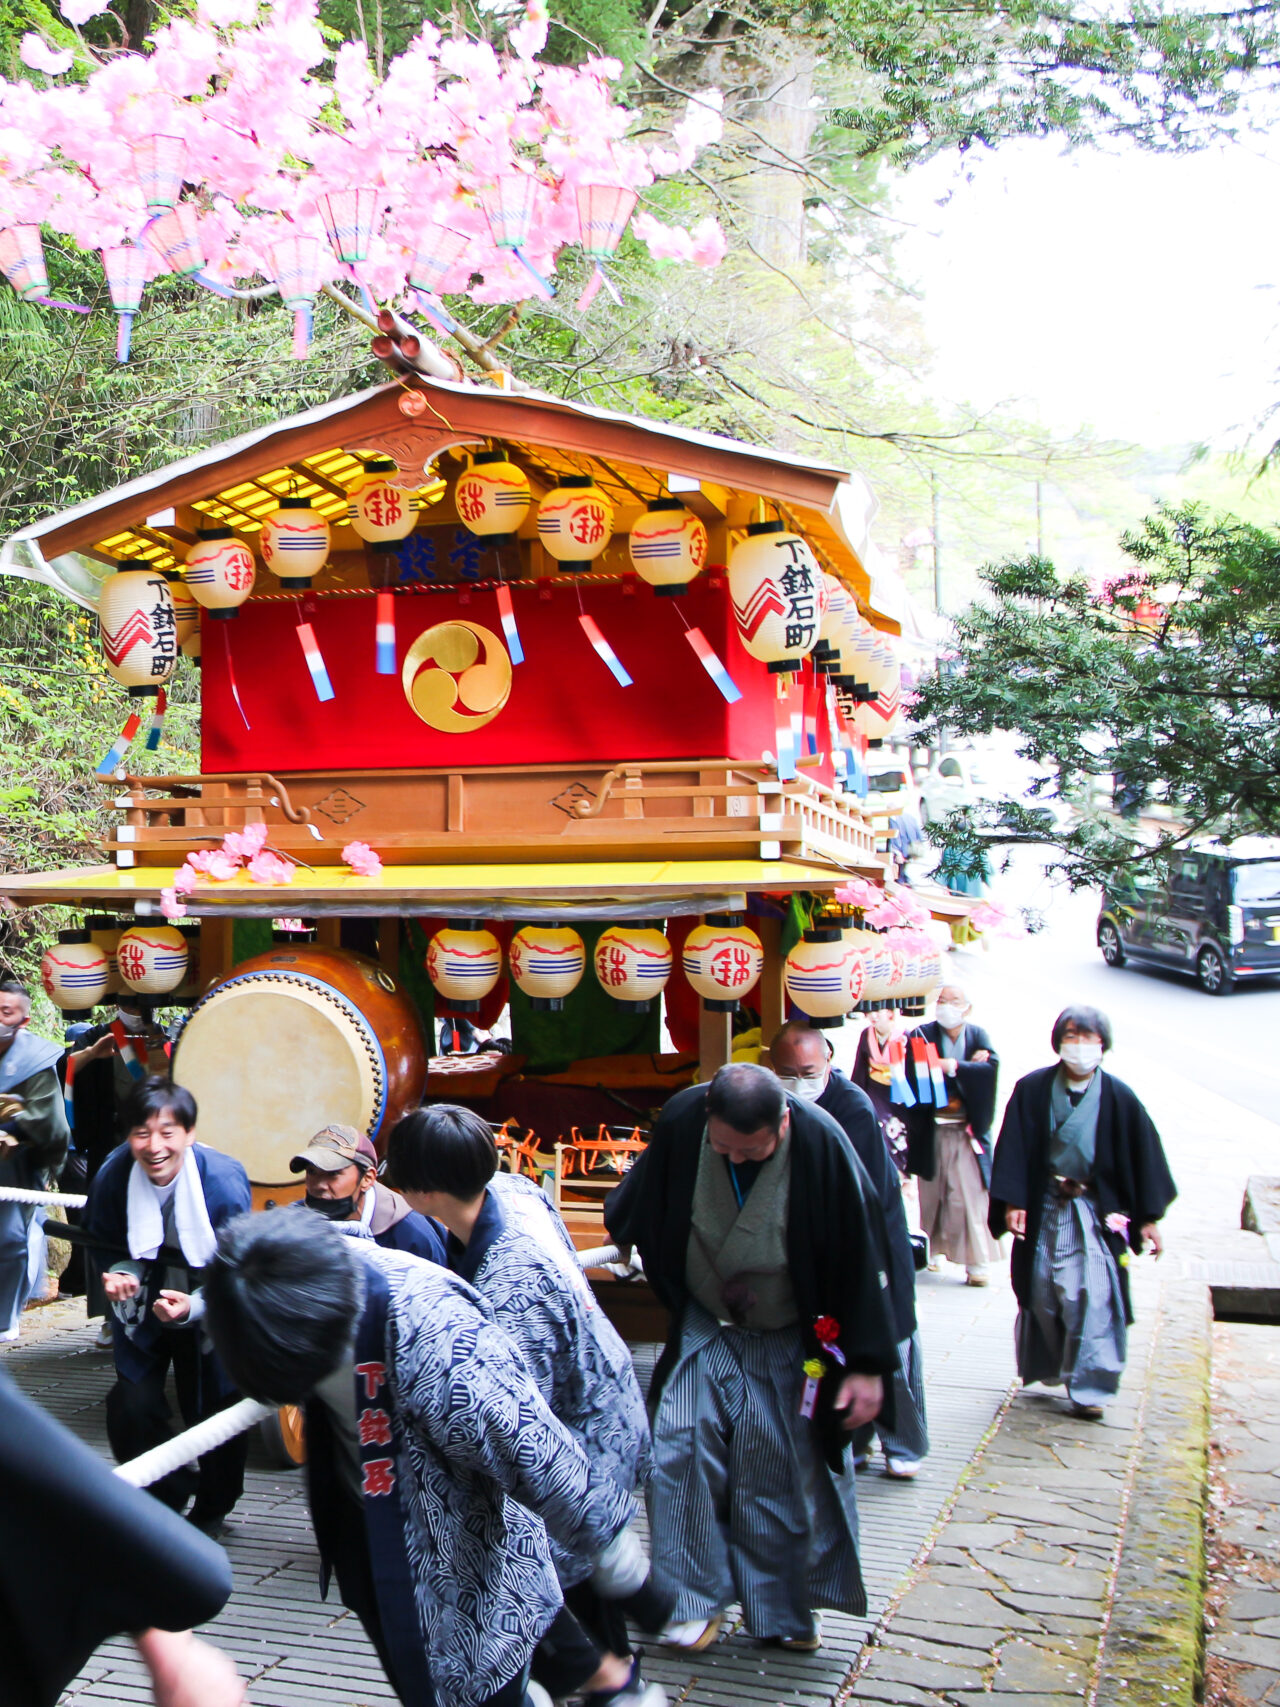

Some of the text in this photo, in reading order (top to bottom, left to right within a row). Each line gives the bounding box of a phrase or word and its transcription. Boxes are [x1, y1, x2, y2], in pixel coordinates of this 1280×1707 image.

[147, 579, 176, 677] 下鉢石町
[775, 539, 816, 649] 下鉢石町
